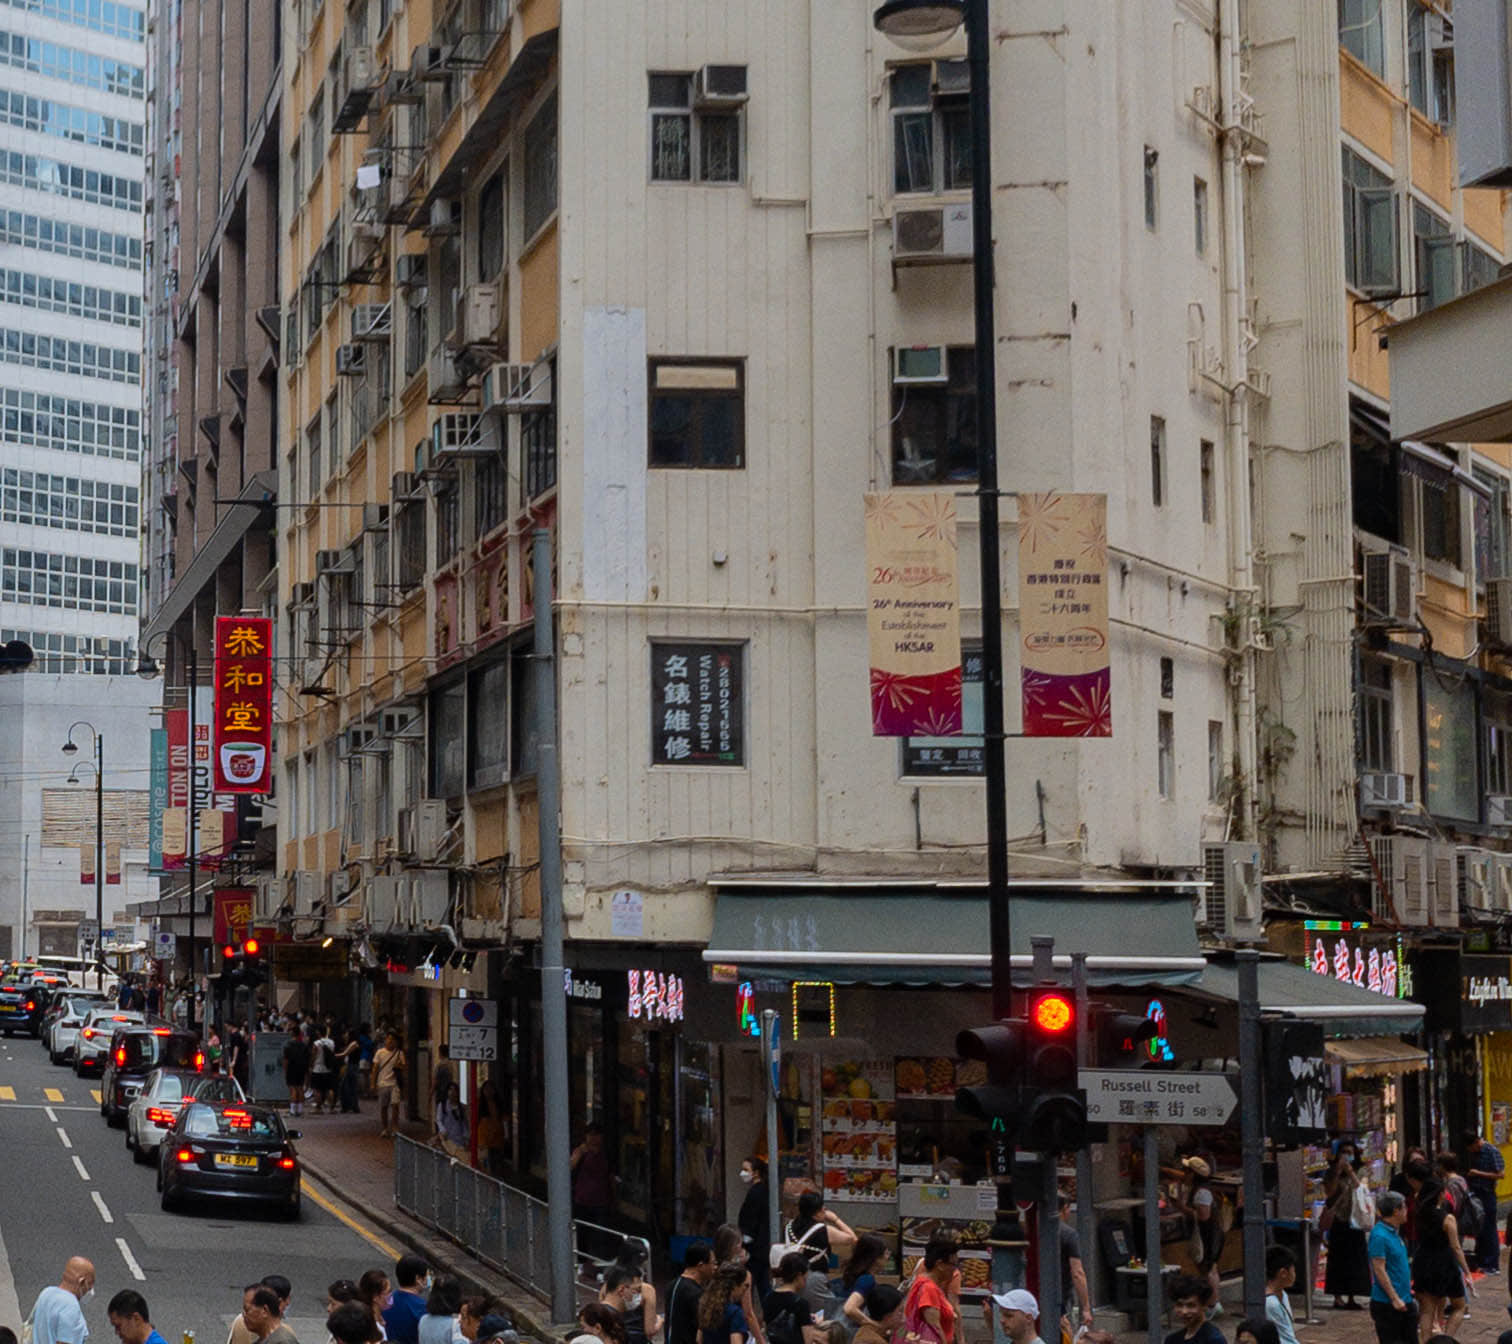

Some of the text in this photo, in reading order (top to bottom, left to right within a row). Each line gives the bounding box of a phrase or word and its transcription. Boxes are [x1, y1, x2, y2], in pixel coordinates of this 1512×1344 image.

[894, 599, 954, 611] Anniversary
[881, 620, 947, 630] Establishment
[894, 641, 935, 653] HKSAR
[222, 625, 265, 733] 恭和堂
[663, 654, 692, 760] 名錶維修
[697, 654, 713, 752] Watch Repair
[479, 1028, 488, 1041] 7
[479, 1047, 494, 1058] 12
[1101, 1079, 1201, 1094] Russell Street
[1118, 1099, 1185, 1118] 羅素街
